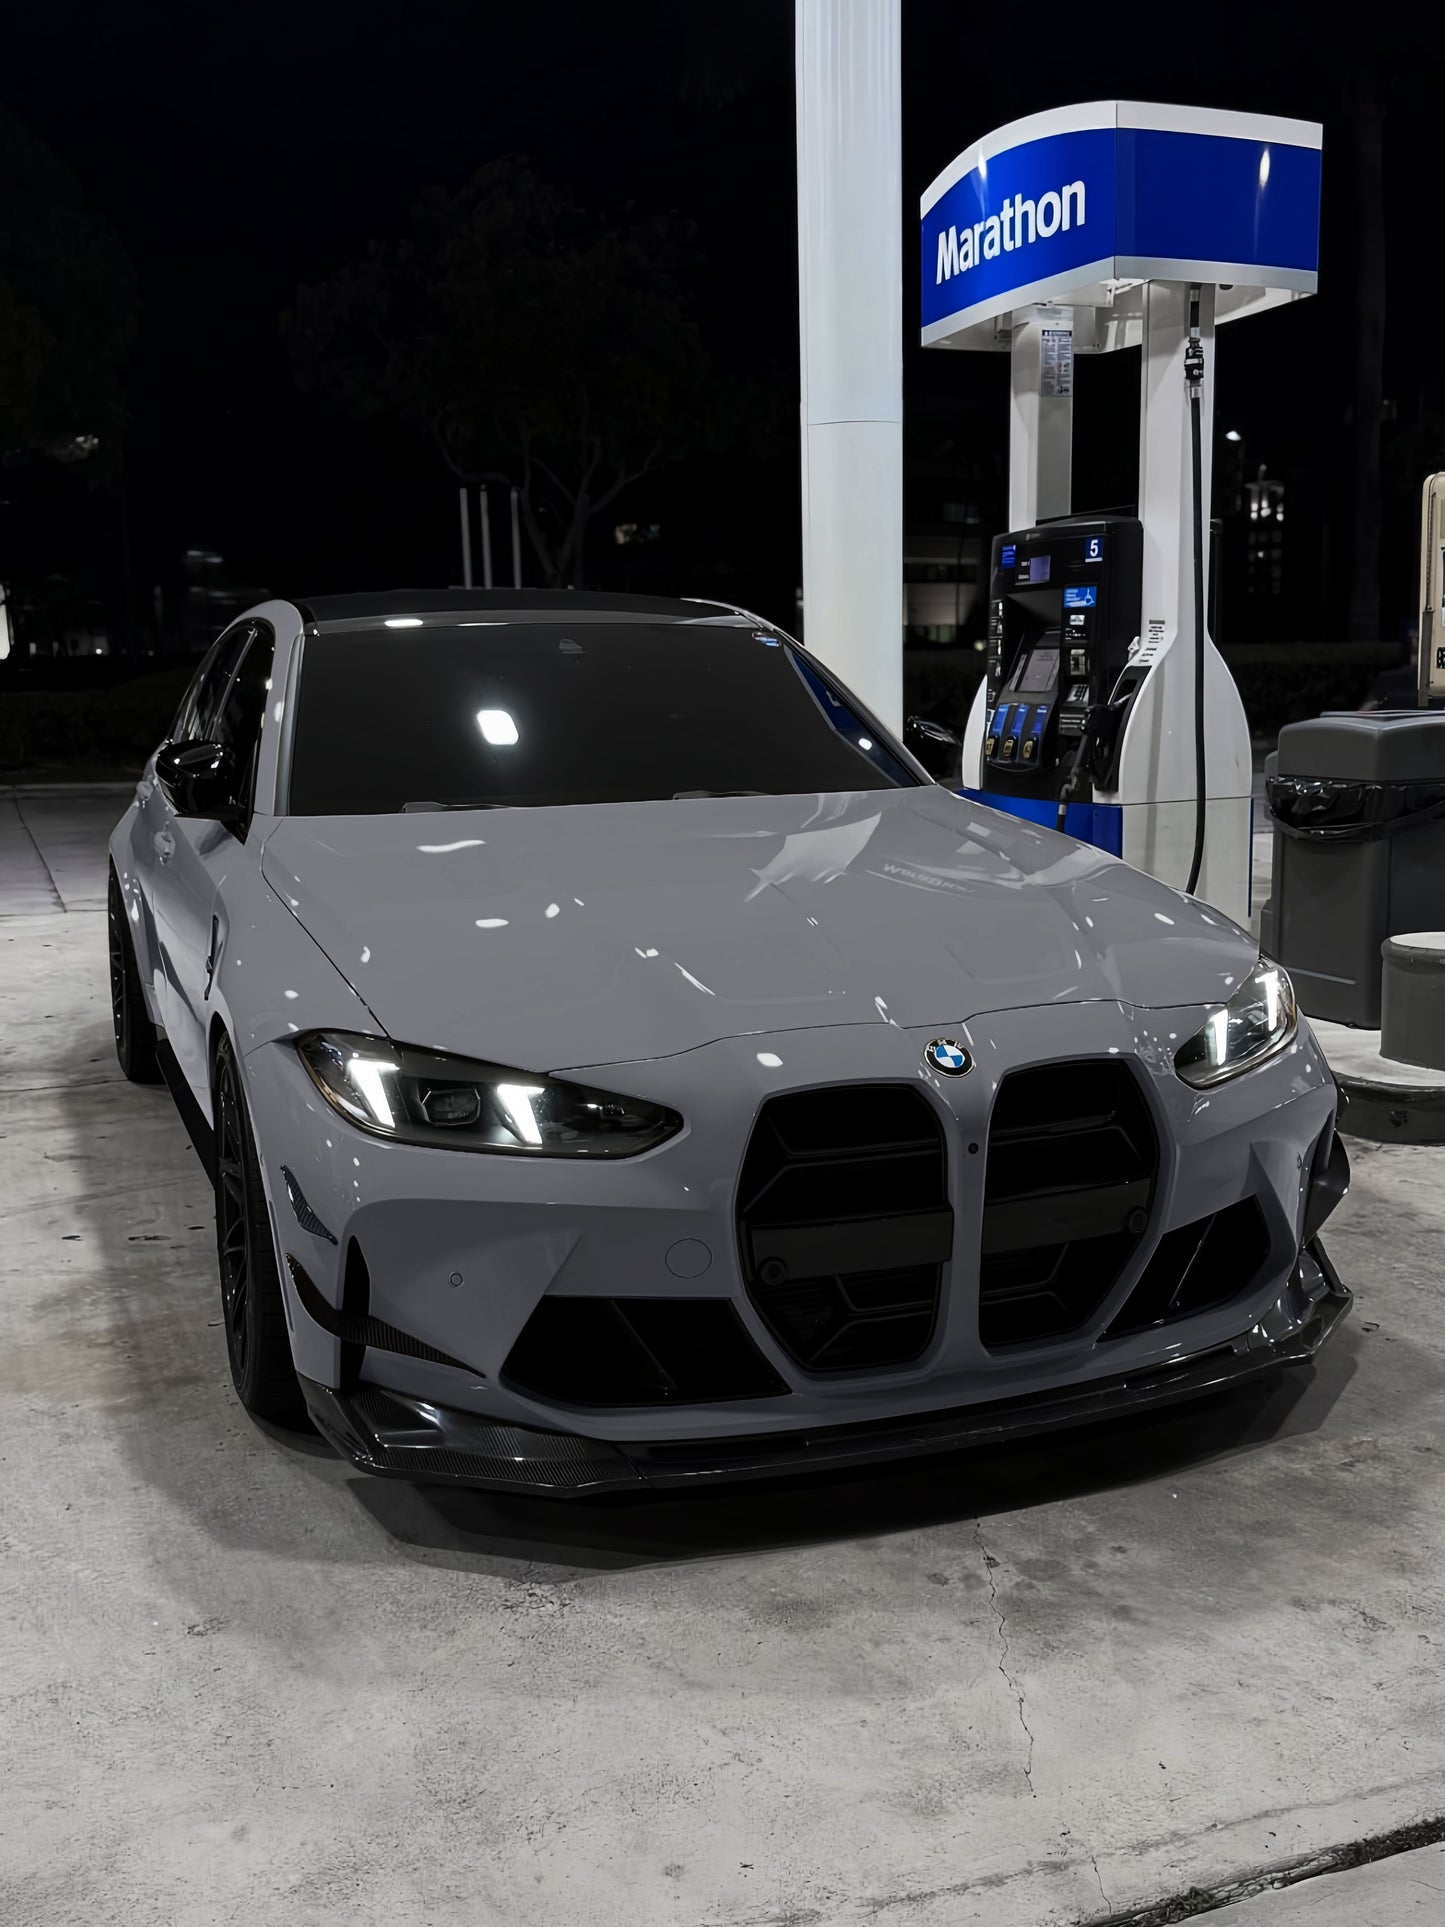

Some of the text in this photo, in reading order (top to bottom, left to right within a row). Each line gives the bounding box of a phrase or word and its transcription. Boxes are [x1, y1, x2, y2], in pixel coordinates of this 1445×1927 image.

[936, 180, 1086, 285] Marathon
[1089, 539, 1099, 557] 5
[929, 1039, 964, 1052] BMW
